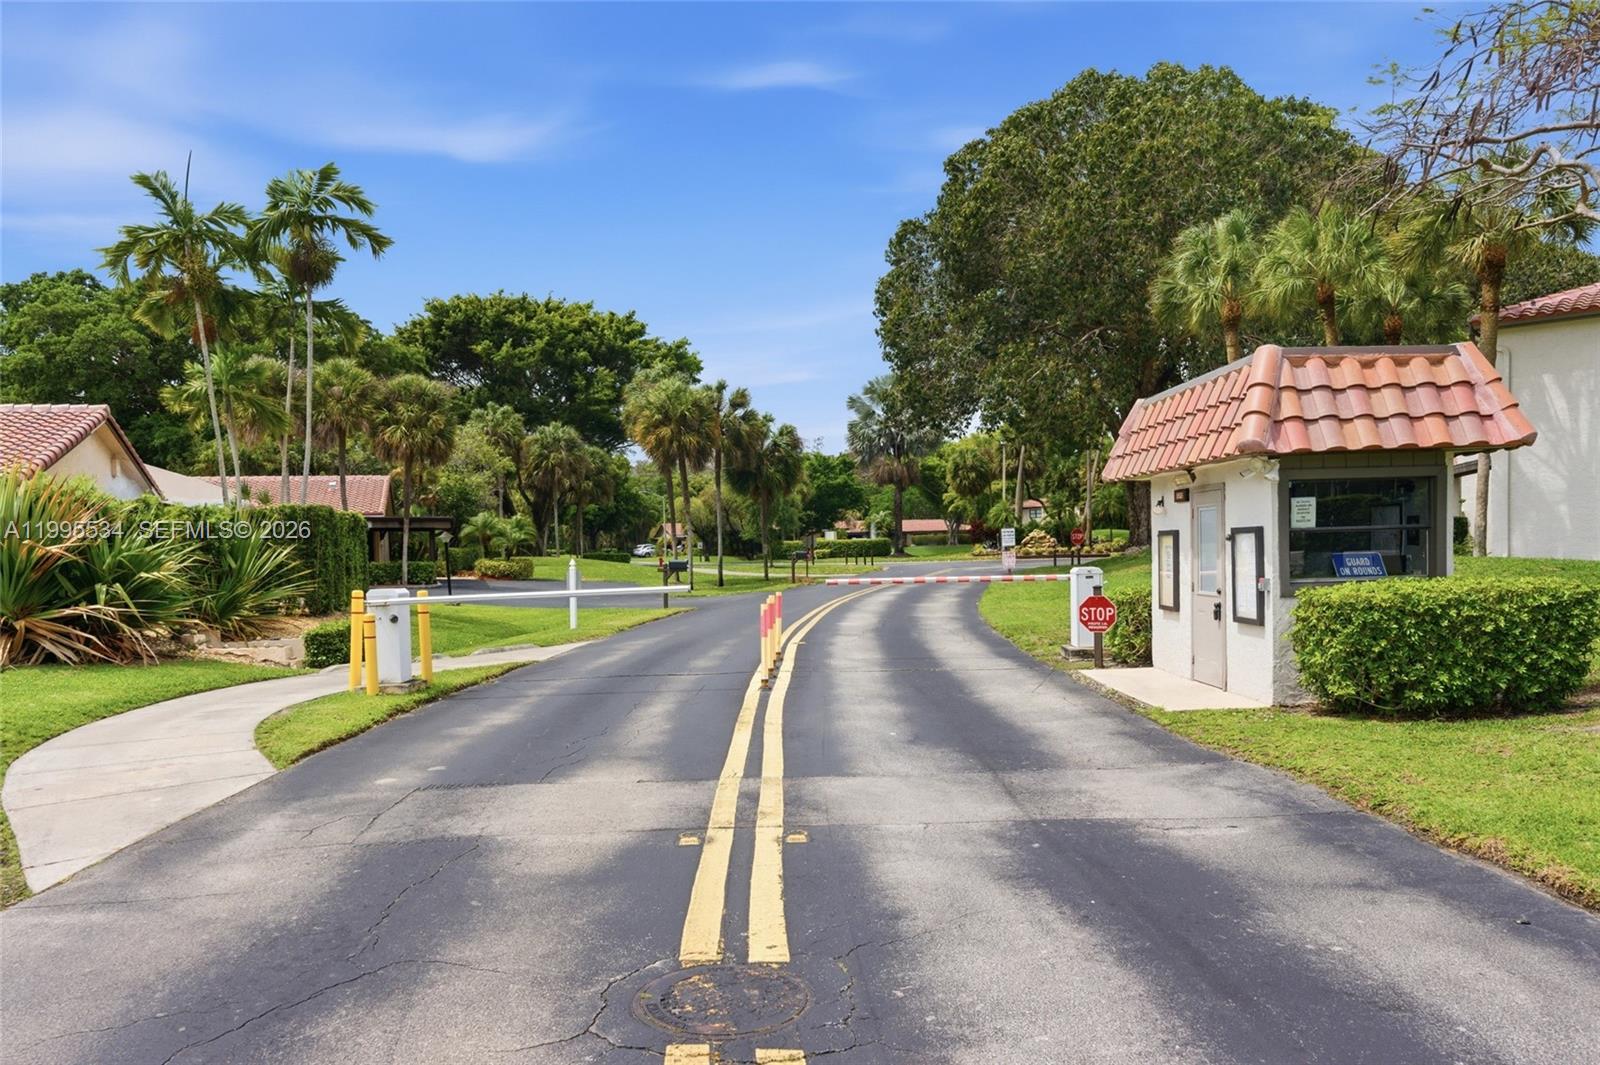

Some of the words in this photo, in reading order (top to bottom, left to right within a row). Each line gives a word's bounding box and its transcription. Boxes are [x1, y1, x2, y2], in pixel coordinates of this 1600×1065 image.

[1346, 557, 1370, 566] GUARD
[1340, 567, 1351, 575] ON
[1353, 566, 1382, 575] ROUNDS
[1081, 607, 1114, 621] STOP
